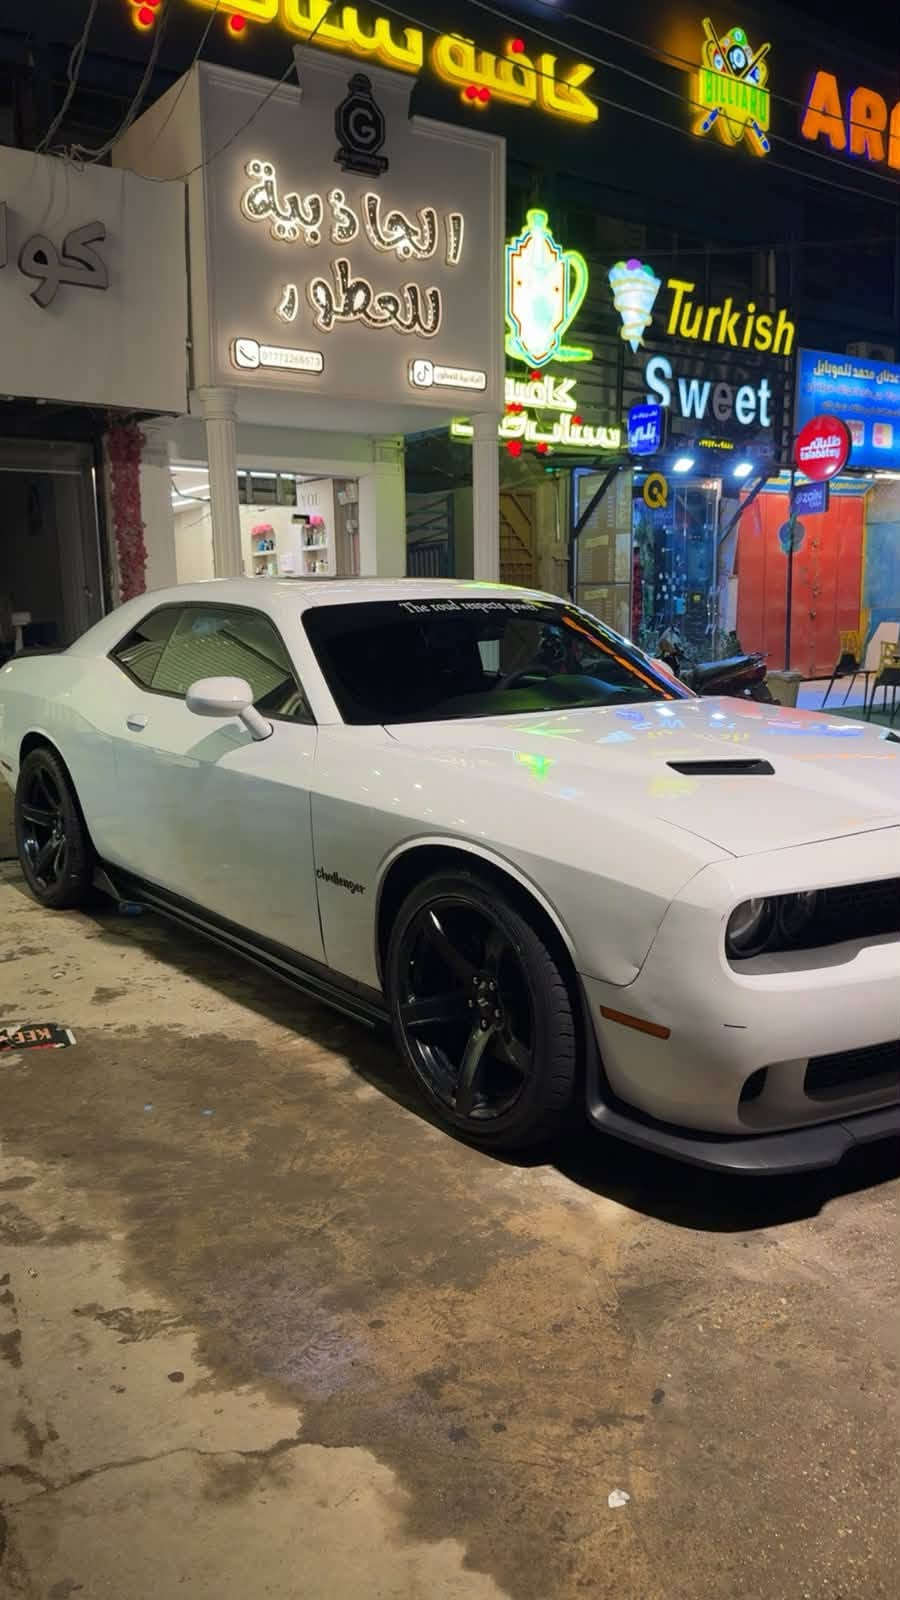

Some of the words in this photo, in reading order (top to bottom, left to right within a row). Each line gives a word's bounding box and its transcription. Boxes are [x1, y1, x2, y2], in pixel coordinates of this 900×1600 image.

[704, 68, 768, 123] BILLIARD
[348, 106, 377, 145] G
[801, 70, 900, 171] AR
[666, 279, 797, 356] Turkish
[505, 370, 577, 413] كافي
[645, 355, 771, 428] Sweet
[400, 601, 431, 614] The
[430, 600, 461, 612] road
[316, 866, 367, 895] challenger
